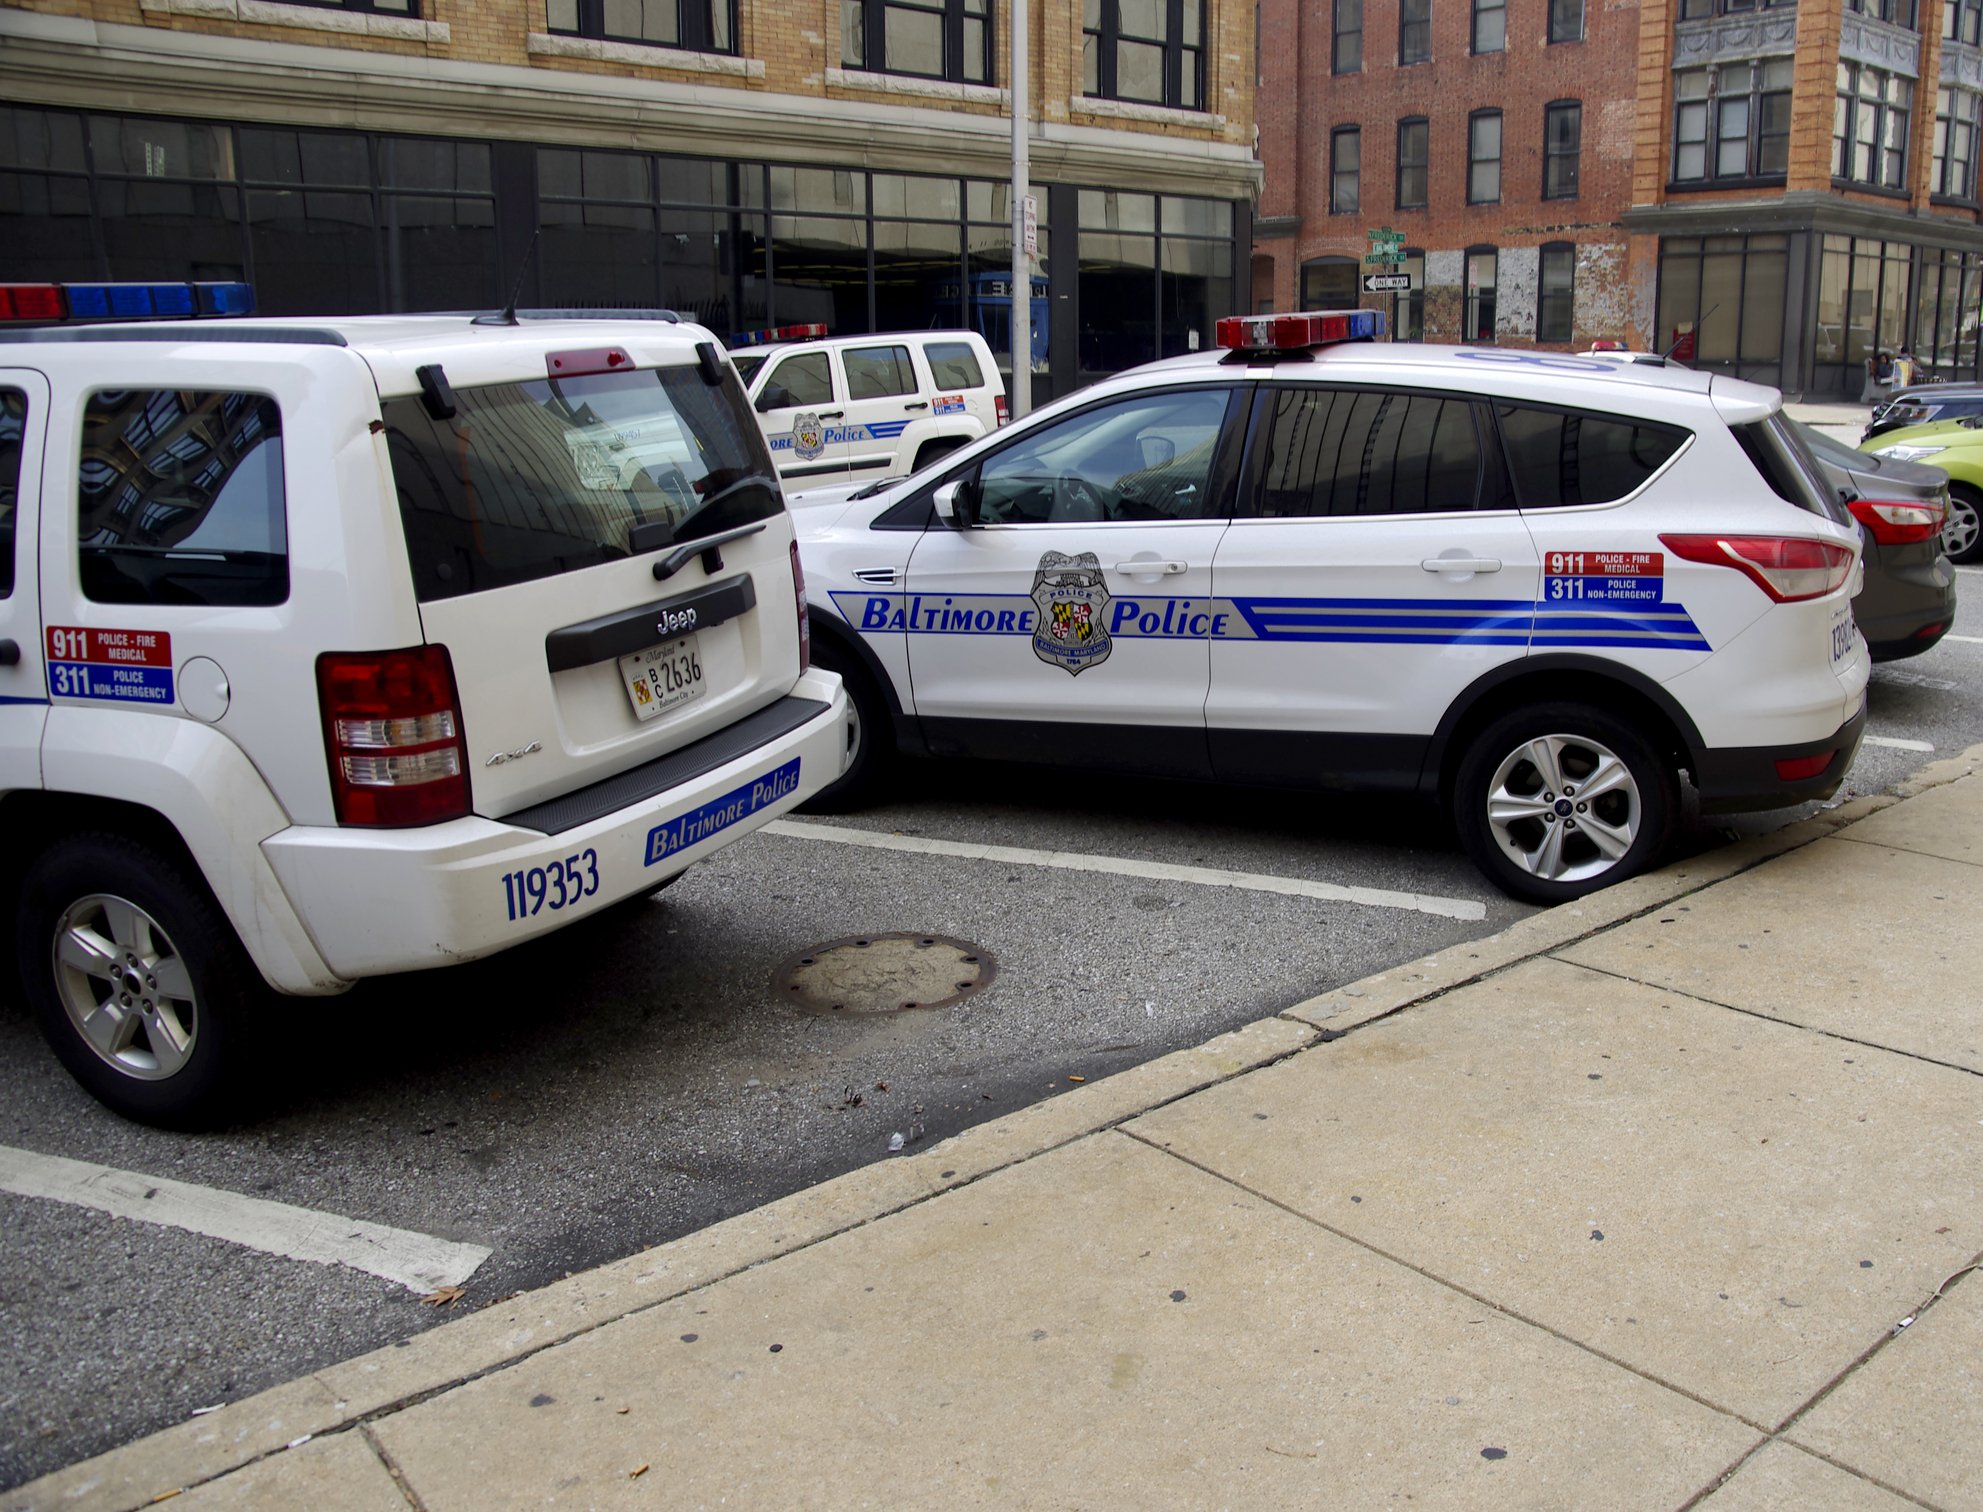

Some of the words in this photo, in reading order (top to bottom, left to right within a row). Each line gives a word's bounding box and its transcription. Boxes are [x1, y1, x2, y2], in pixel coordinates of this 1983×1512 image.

[1375, 278, 1388, 287] ONE
[1392, 276, 1408, 285] WAY
[824, 426, 865, 443] Police
[1551, 553, 1584, 573] 911
[1595, 554, 1624, 564] POLICE
[1632, 555, 1650, 564] FIRE
[1604, 564, 1640, 573] MEDICAL
[1049, 589, 1093, 600] POLICE
[1551, 578, 1584, 599] 311
[1608, 580, 1636, 589] POLICE
[1588, 590, 1657, 599] NON-EMERGENCY
[657, 607, 698, 635] Jeep
[53, 629, 88, 659] 911
[98, 633, 128, 645] POLICE
[136, 635, 156, 647] FIRE
[1039, 642, 1072, 656] BALTIMORE
[1074, 642, 1107, 656] MARYLAND
[108, 648, 147, 661] MEDICAL
[55, 665, 90, 695] 311
[113, 670, 144, 683] POLICE
[661, 652, 701, 693] 2636
[93, 683, 167, 699] NON-EMERGENCY
[501, 848, 600, 921] 119353
